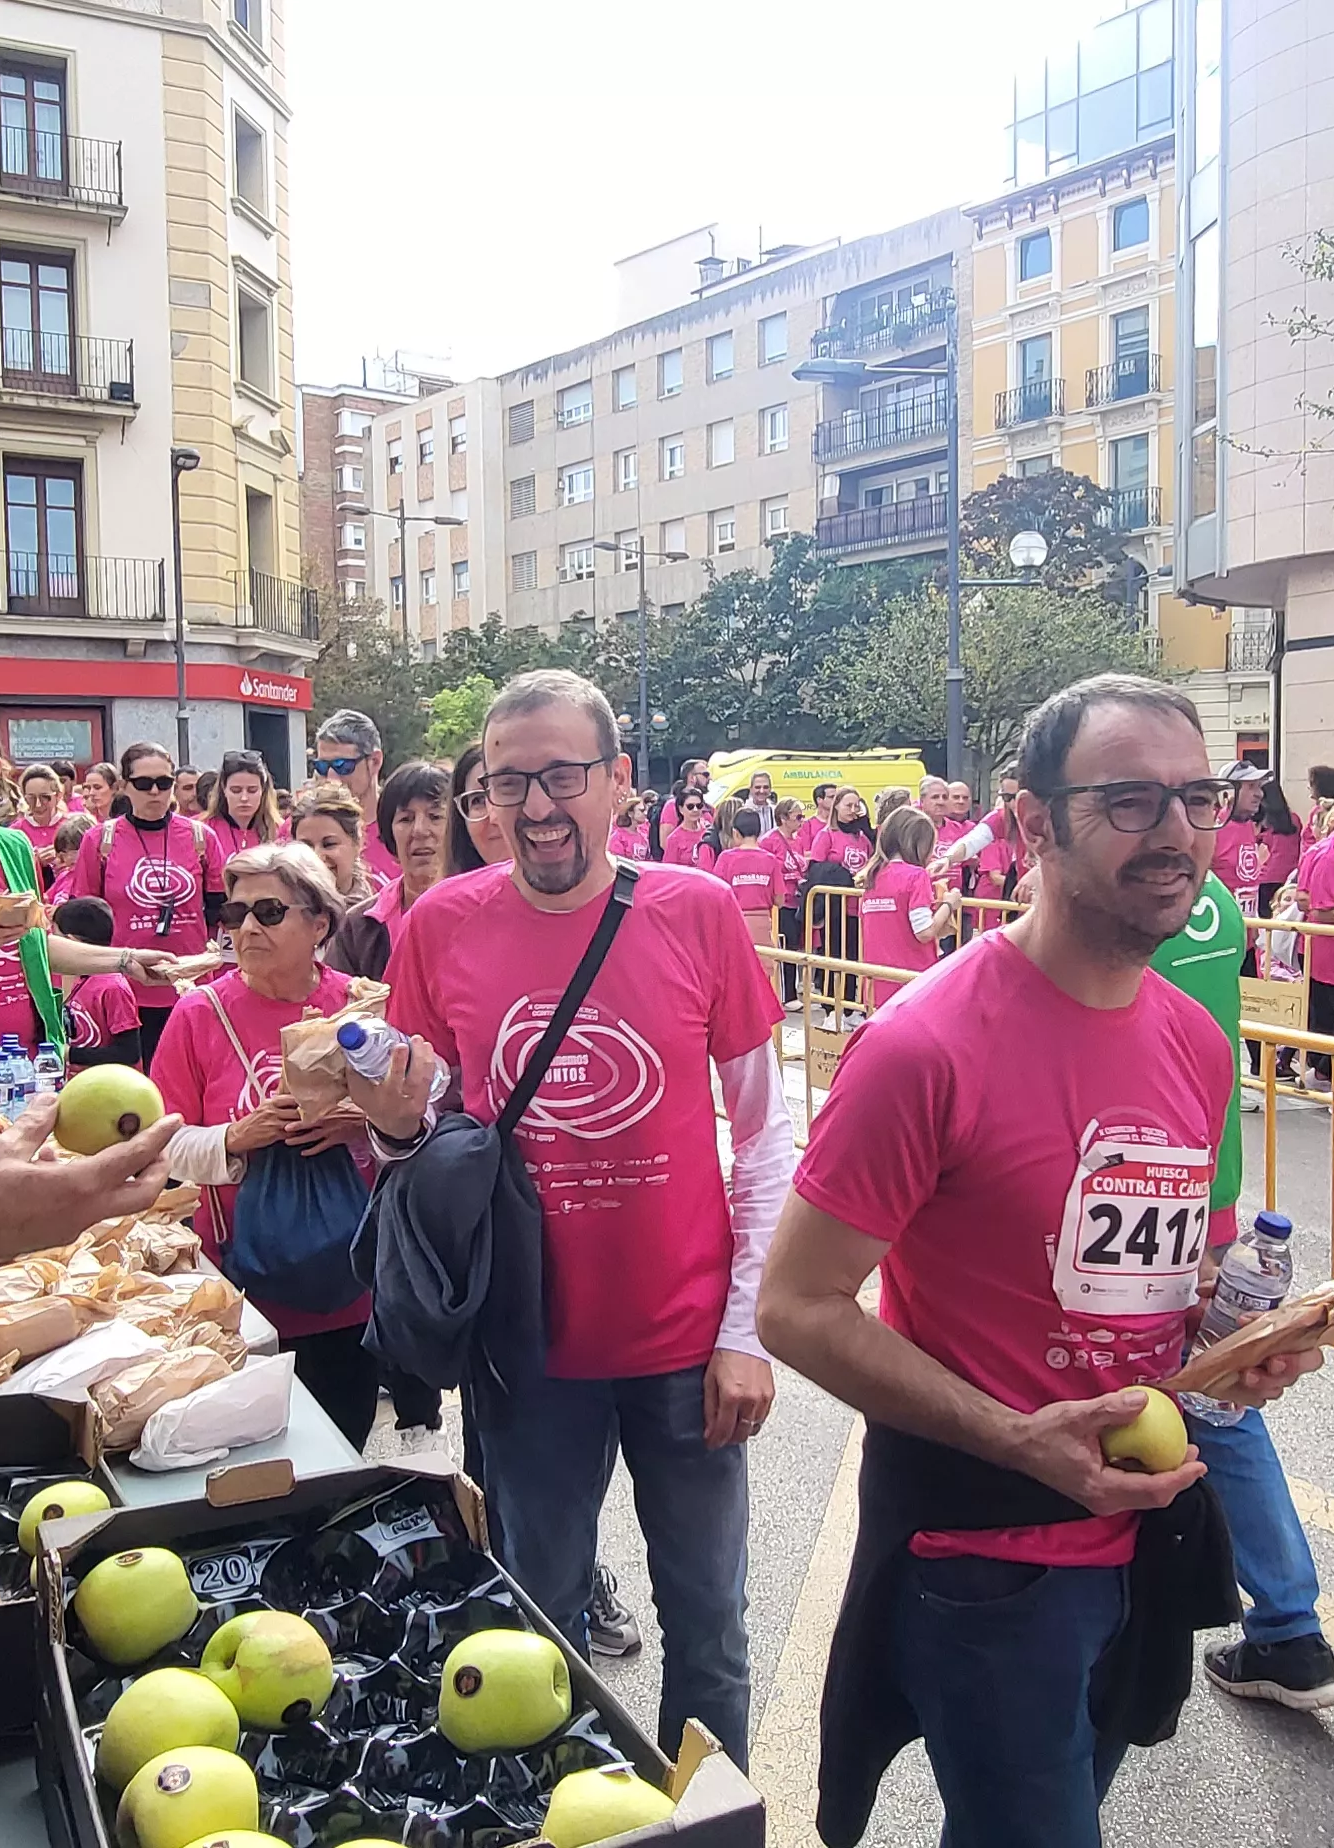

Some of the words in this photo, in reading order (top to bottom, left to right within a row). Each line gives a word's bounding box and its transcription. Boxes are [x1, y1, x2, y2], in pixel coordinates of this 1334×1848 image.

[252, 678, 298, 702] Santander
[783, 770, 843, 779] AMBULANCIA
[543, 1066, 586, 1084] UNTOS
[1146, 1165, 1189, 1180] HUESCA
[1092, 1176, 1156, 1195] CONTRA
[1160, 1180, 1176, 1196] EL
[1081, 1203, 1205, 1266] 2412
[196, 1555, 247, 1592] 20
